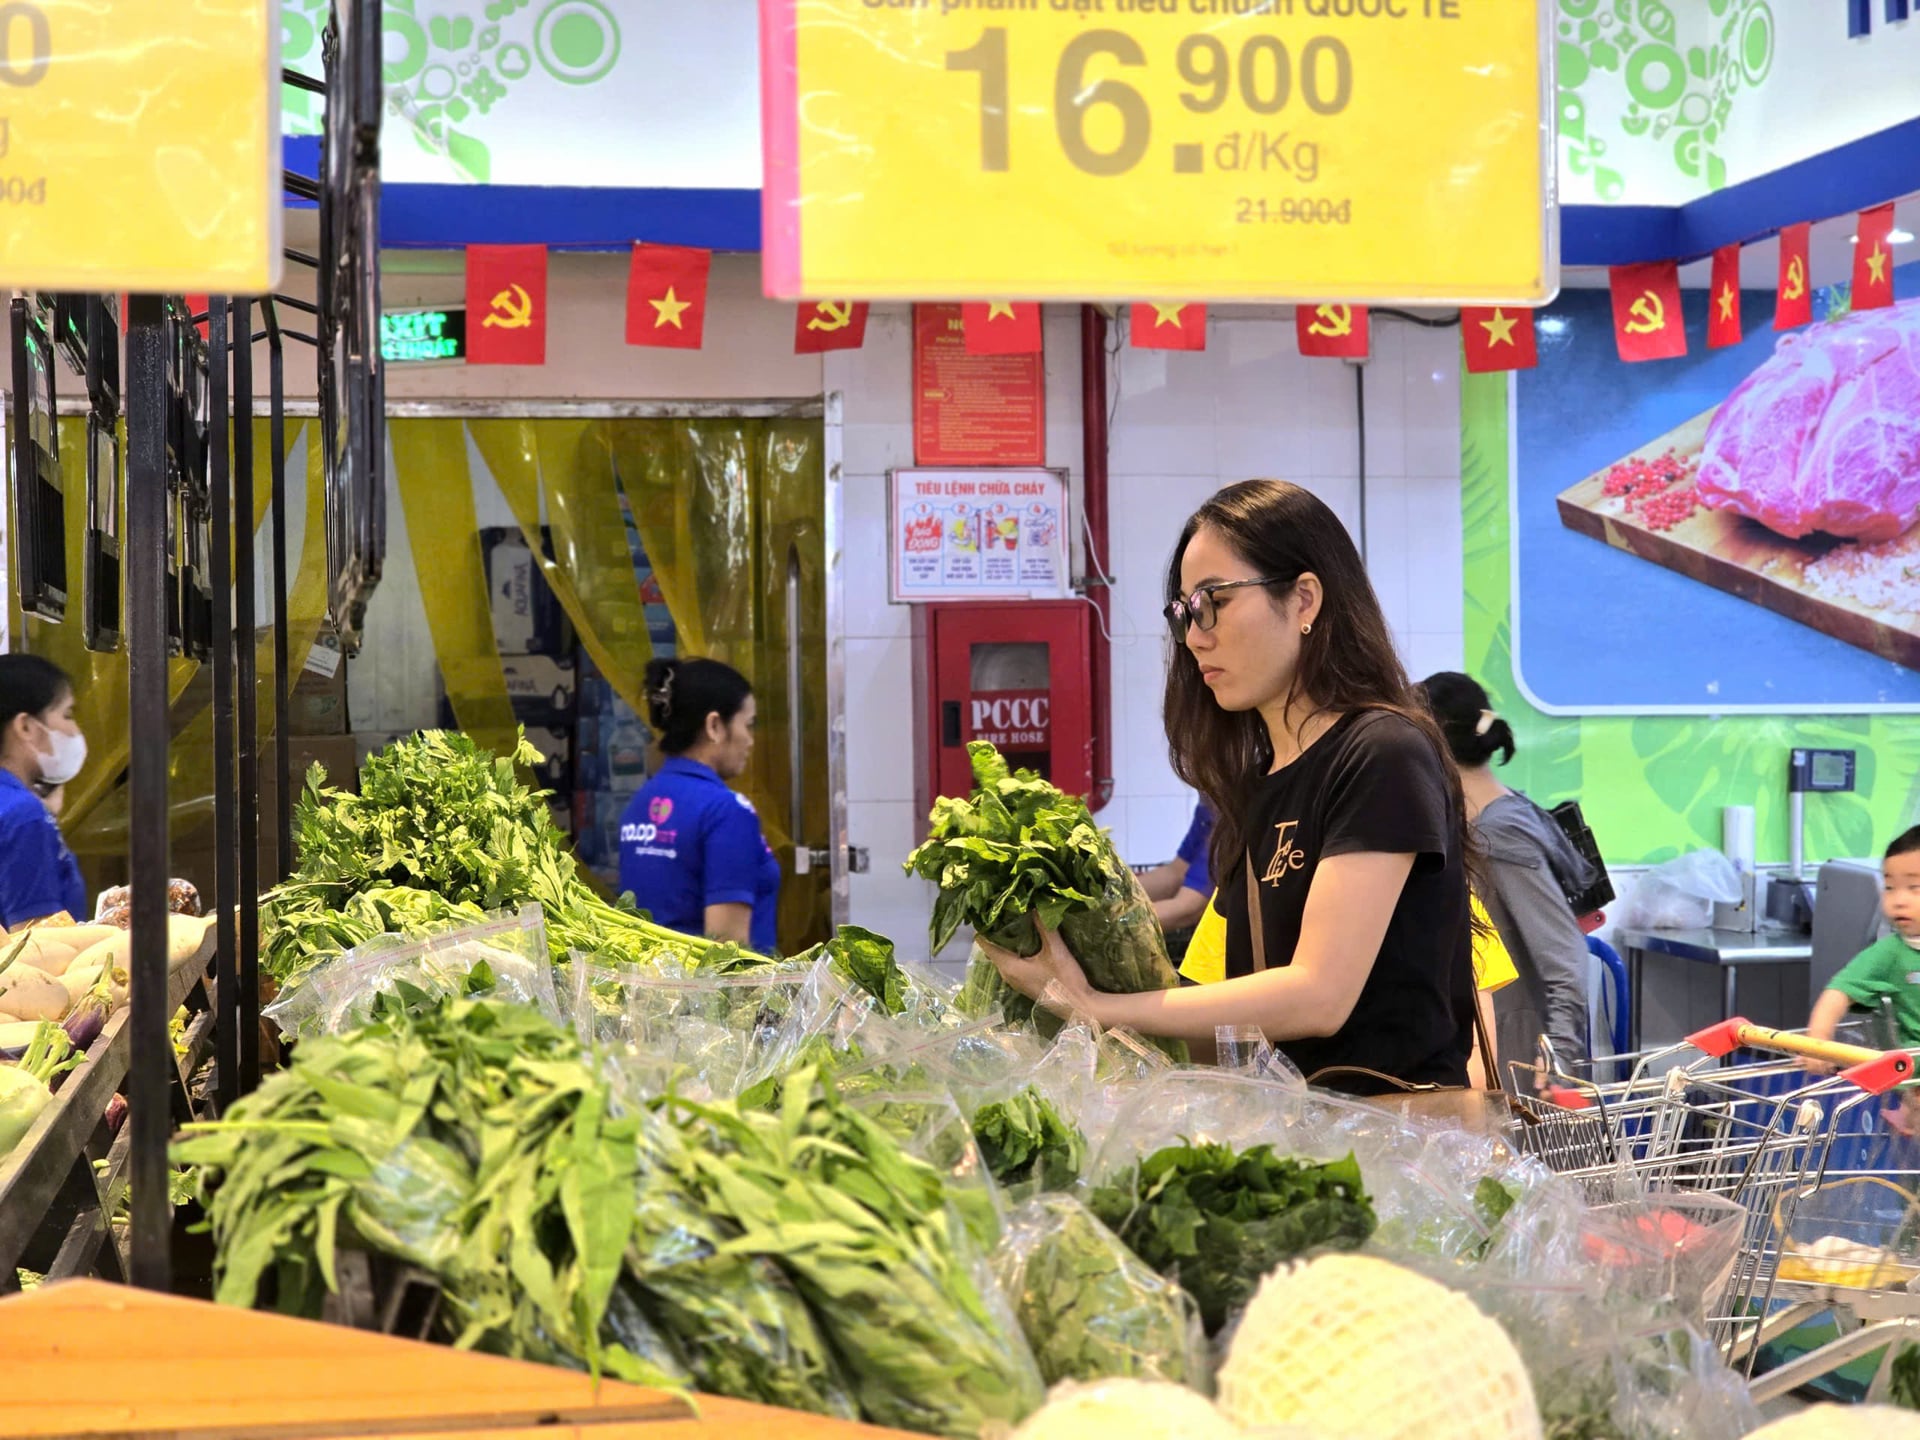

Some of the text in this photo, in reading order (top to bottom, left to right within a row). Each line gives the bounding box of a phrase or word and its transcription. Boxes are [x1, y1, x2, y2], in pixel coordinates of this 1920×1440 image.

[944, 480, 975, 497] LỆNH
[1014, 480, 1045, 495] CHÁY
[971, 698, 1049, 730] PCCC
[1011, 731, 1044, 743] HOSE
